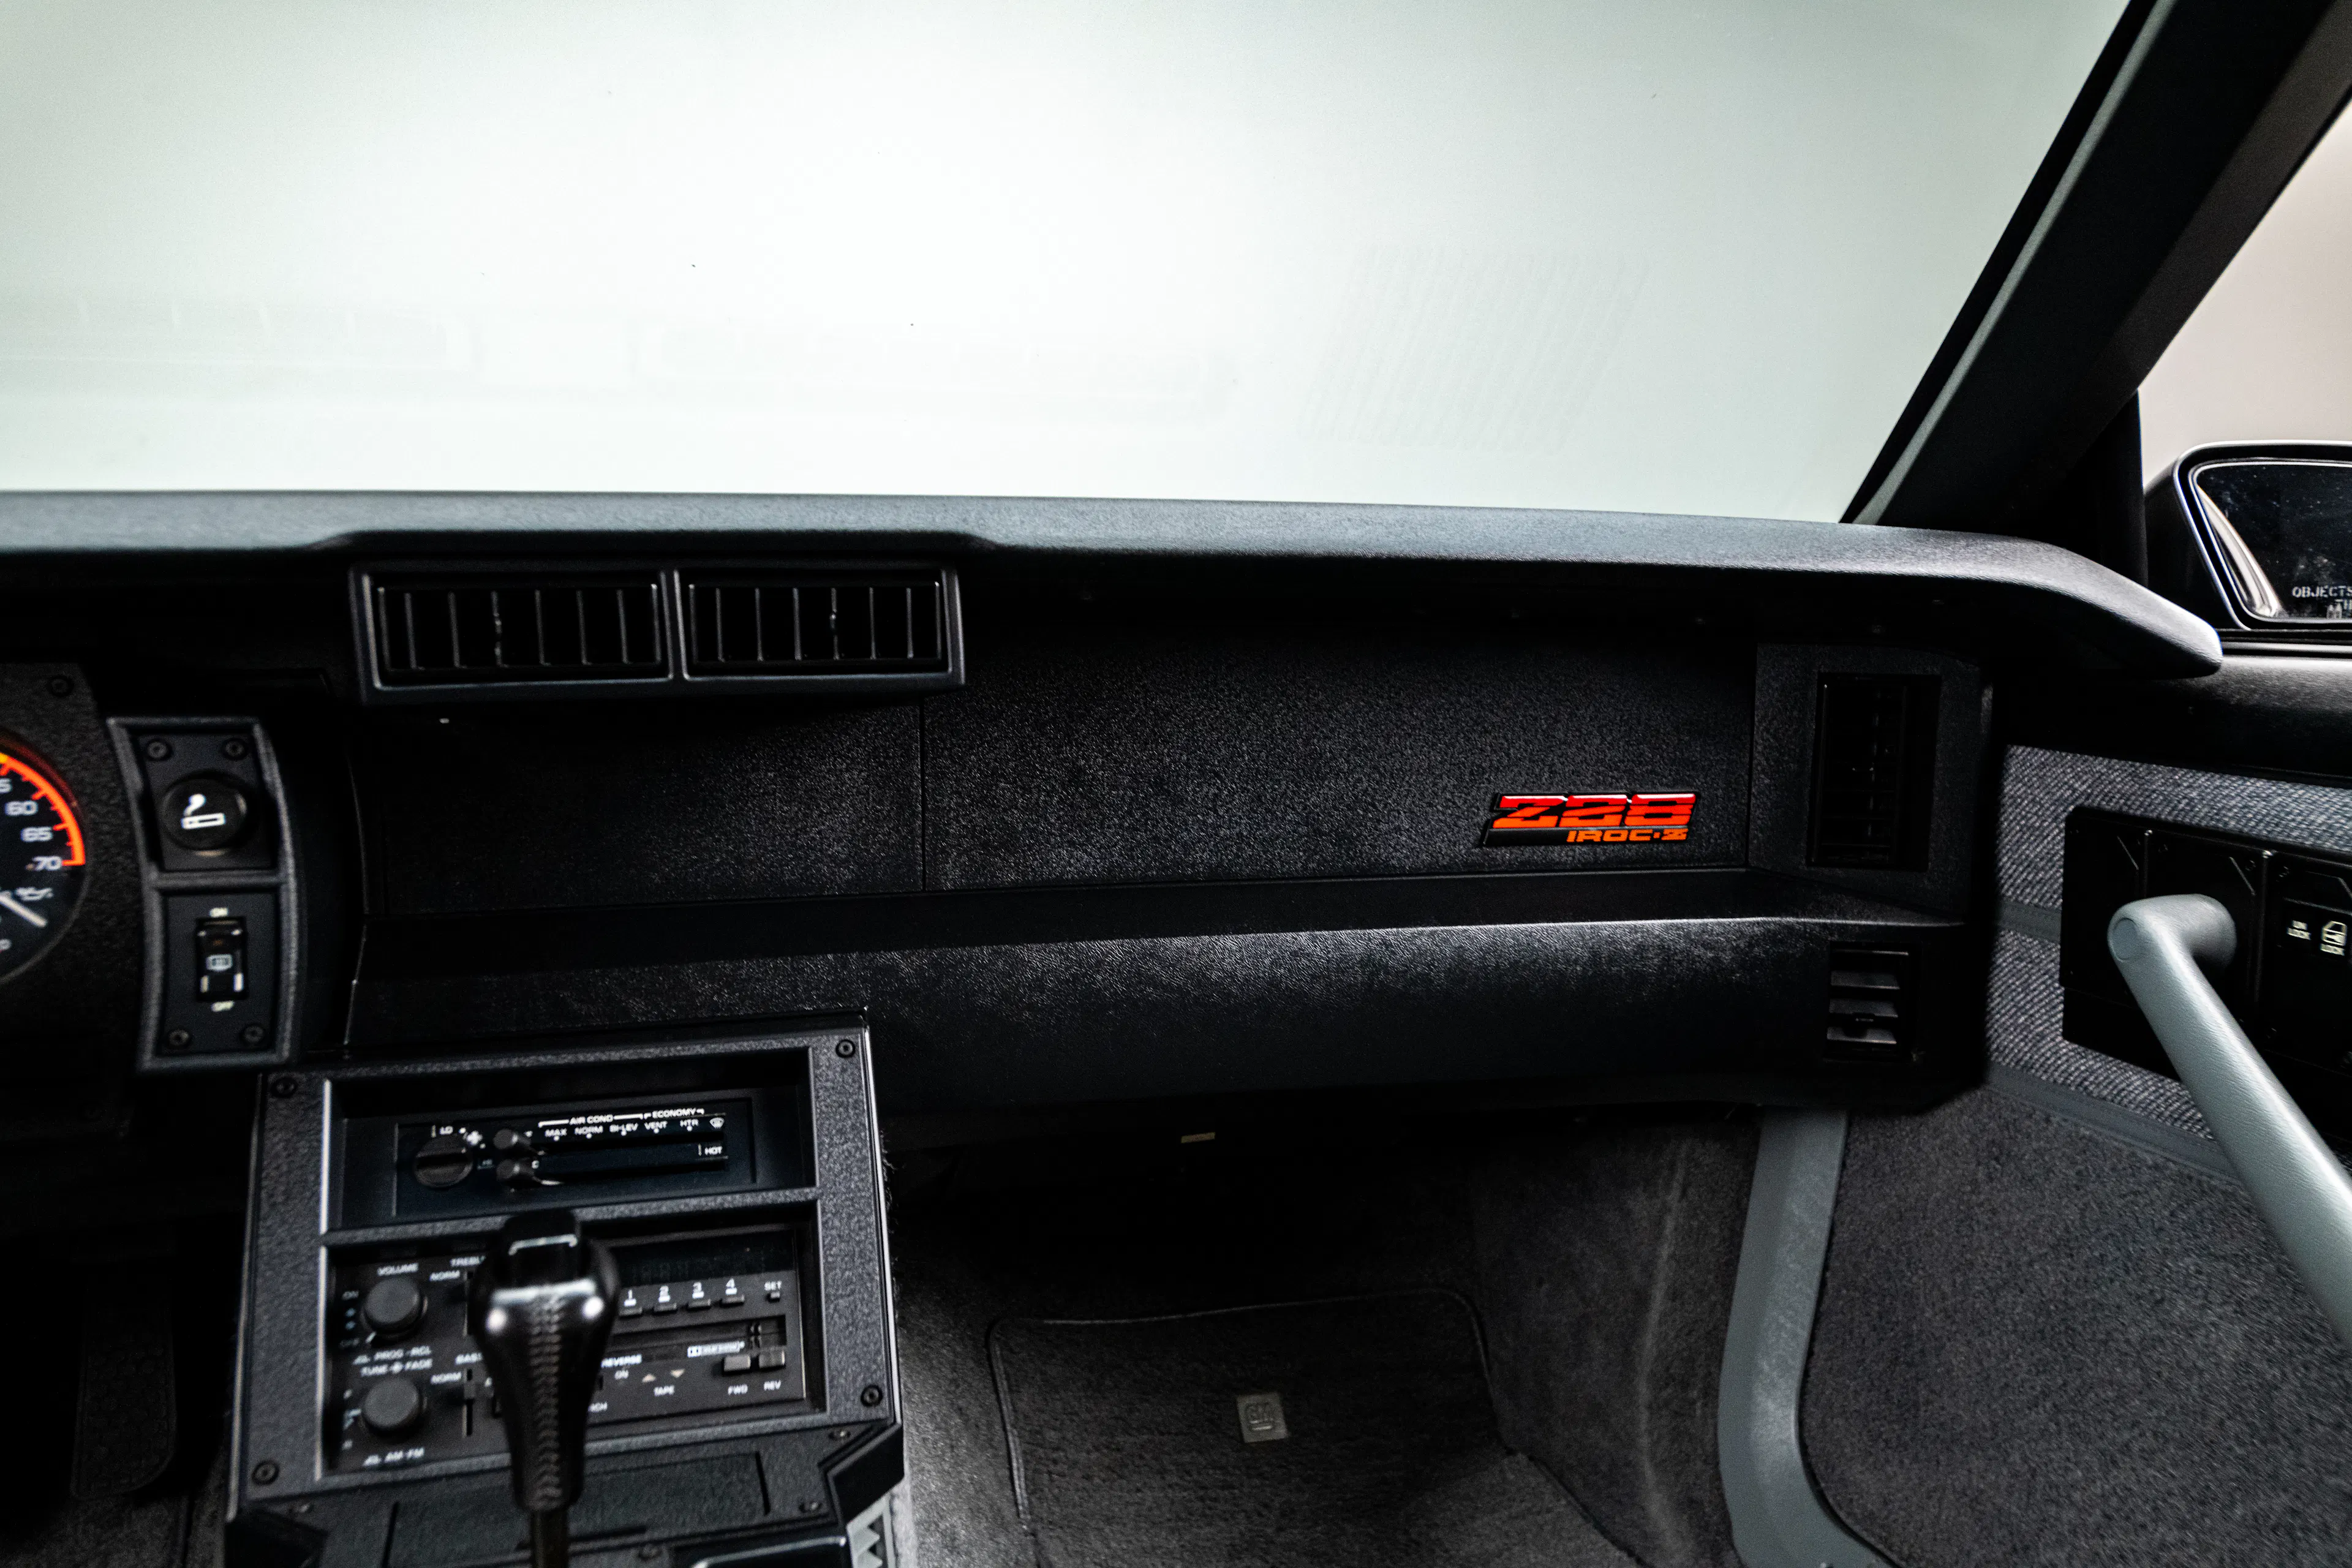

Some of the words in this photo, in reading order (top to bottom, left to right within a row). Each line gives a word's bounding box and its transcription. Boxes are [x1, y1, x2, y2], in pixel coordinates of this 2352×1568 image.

[2291, 586, 2352, 598] OBJECTS
[5, 801, 39, 816] 60
[1493, 794, 1695, 829] Z28
[21, 827, 53, 842] 65
[32, 856, 62, 870] 70
[569, 1117, 586, 1126] AIR
[587, 1115, 613, 1125] COND
[652, 1108, 697, 1119] ECONOMY
[545, 1128, 567, 1137] MAX
[575, 1126, 603, 1134] NORM
[644, 1121, 668, 1130] VENT
[704, 1146, 723, 1155] HOT
